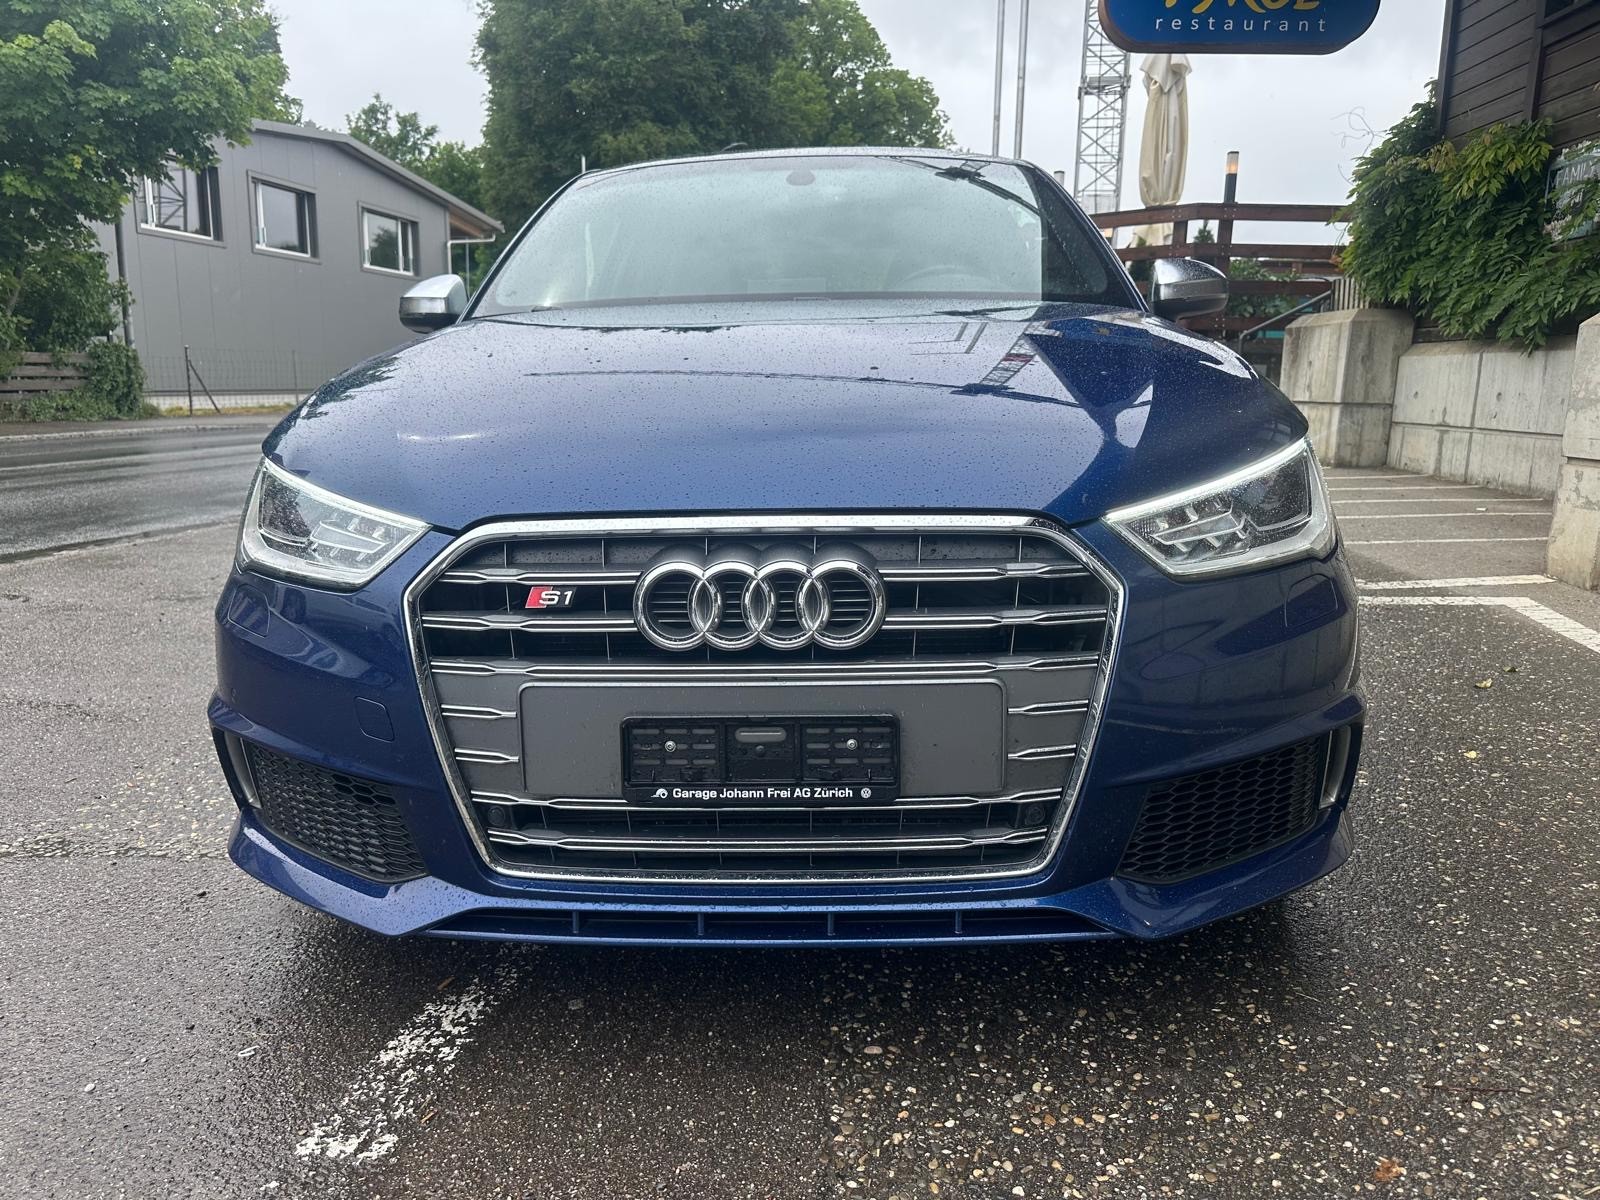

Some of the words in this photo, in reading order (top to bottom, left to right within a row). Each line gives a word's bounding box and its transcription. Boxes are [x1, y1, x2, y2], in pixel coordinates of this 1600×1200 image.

[1155, 16, 1326, 32] restaurant
[539, 590, 573, 605] S1
[672, 787, 717, 800] Garage
[719, 787, 764, 798] Johann
[767, 787, 791, 798] Frei
[793, 787, 811, 798] AG
[813, 786, 853, 798] Zürich
